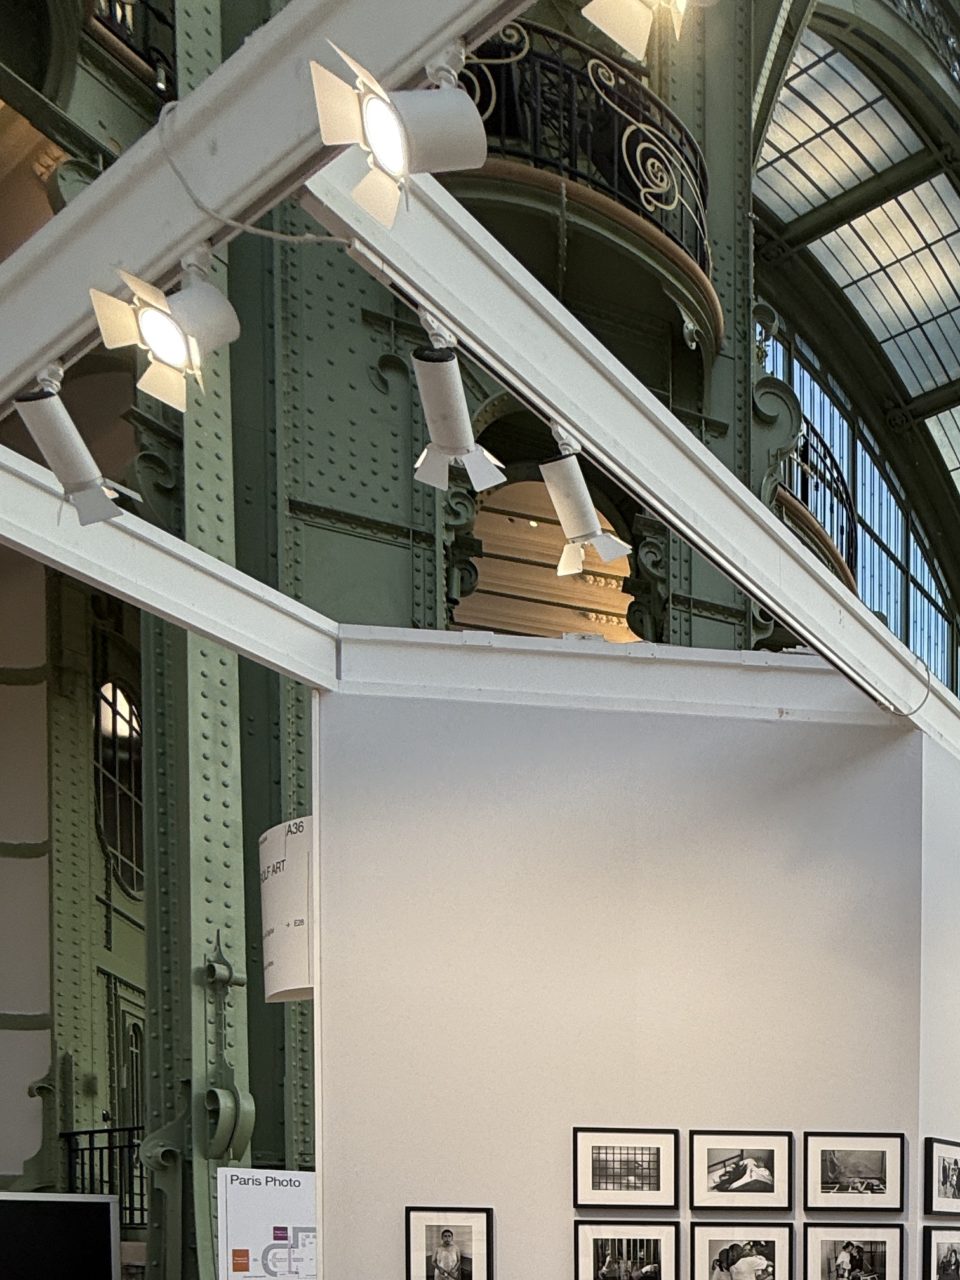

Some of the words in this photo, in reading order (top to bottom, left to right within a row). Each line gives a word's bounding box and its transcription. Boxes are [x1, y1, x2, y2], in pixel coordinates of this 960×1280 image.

[286, 821, 304, 836] A36
[271, 859, 286, 876] ART
[230, 1174, 262, 1186] Paris
[265, 1176, 301, 1188] Photo
